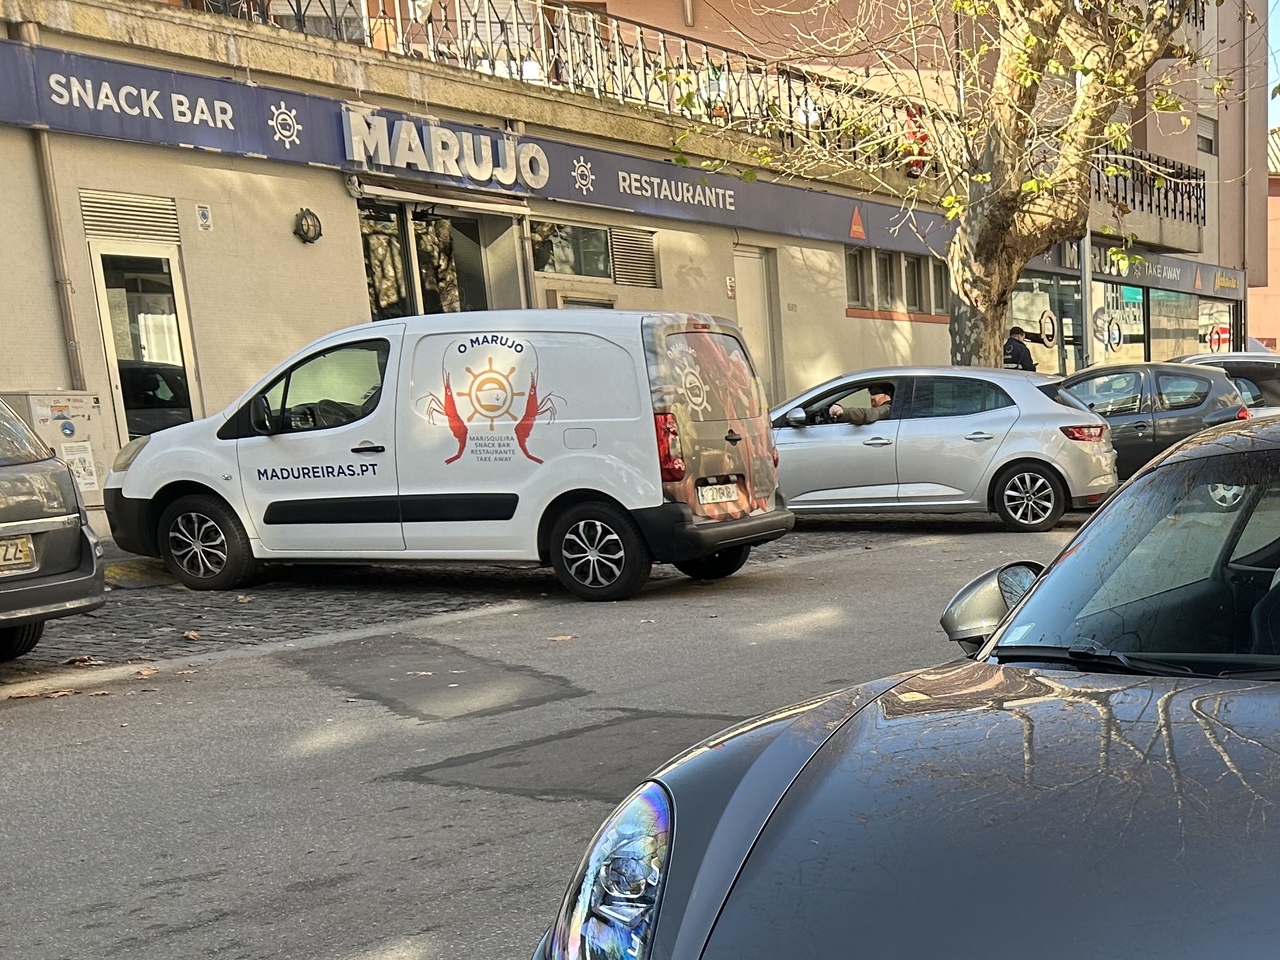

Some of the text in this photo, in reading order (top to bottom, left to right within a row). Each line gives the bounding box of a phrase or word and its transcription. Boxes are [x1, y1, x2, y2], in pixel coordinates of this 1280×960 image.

[49, 73, 235, 130] SNACK BAR
[342, 109, 550, 189] MARUJO
[618, 171, 736, 211] RESTAURANTE
[1061, 241, 1129, 277] MRUJ
[1145, 262, 1180, 280] TAKE AWAY
[458, 335, 524, 354] O MARUJO
[257, 464, 378, 481] MADUREIRAS.PT
